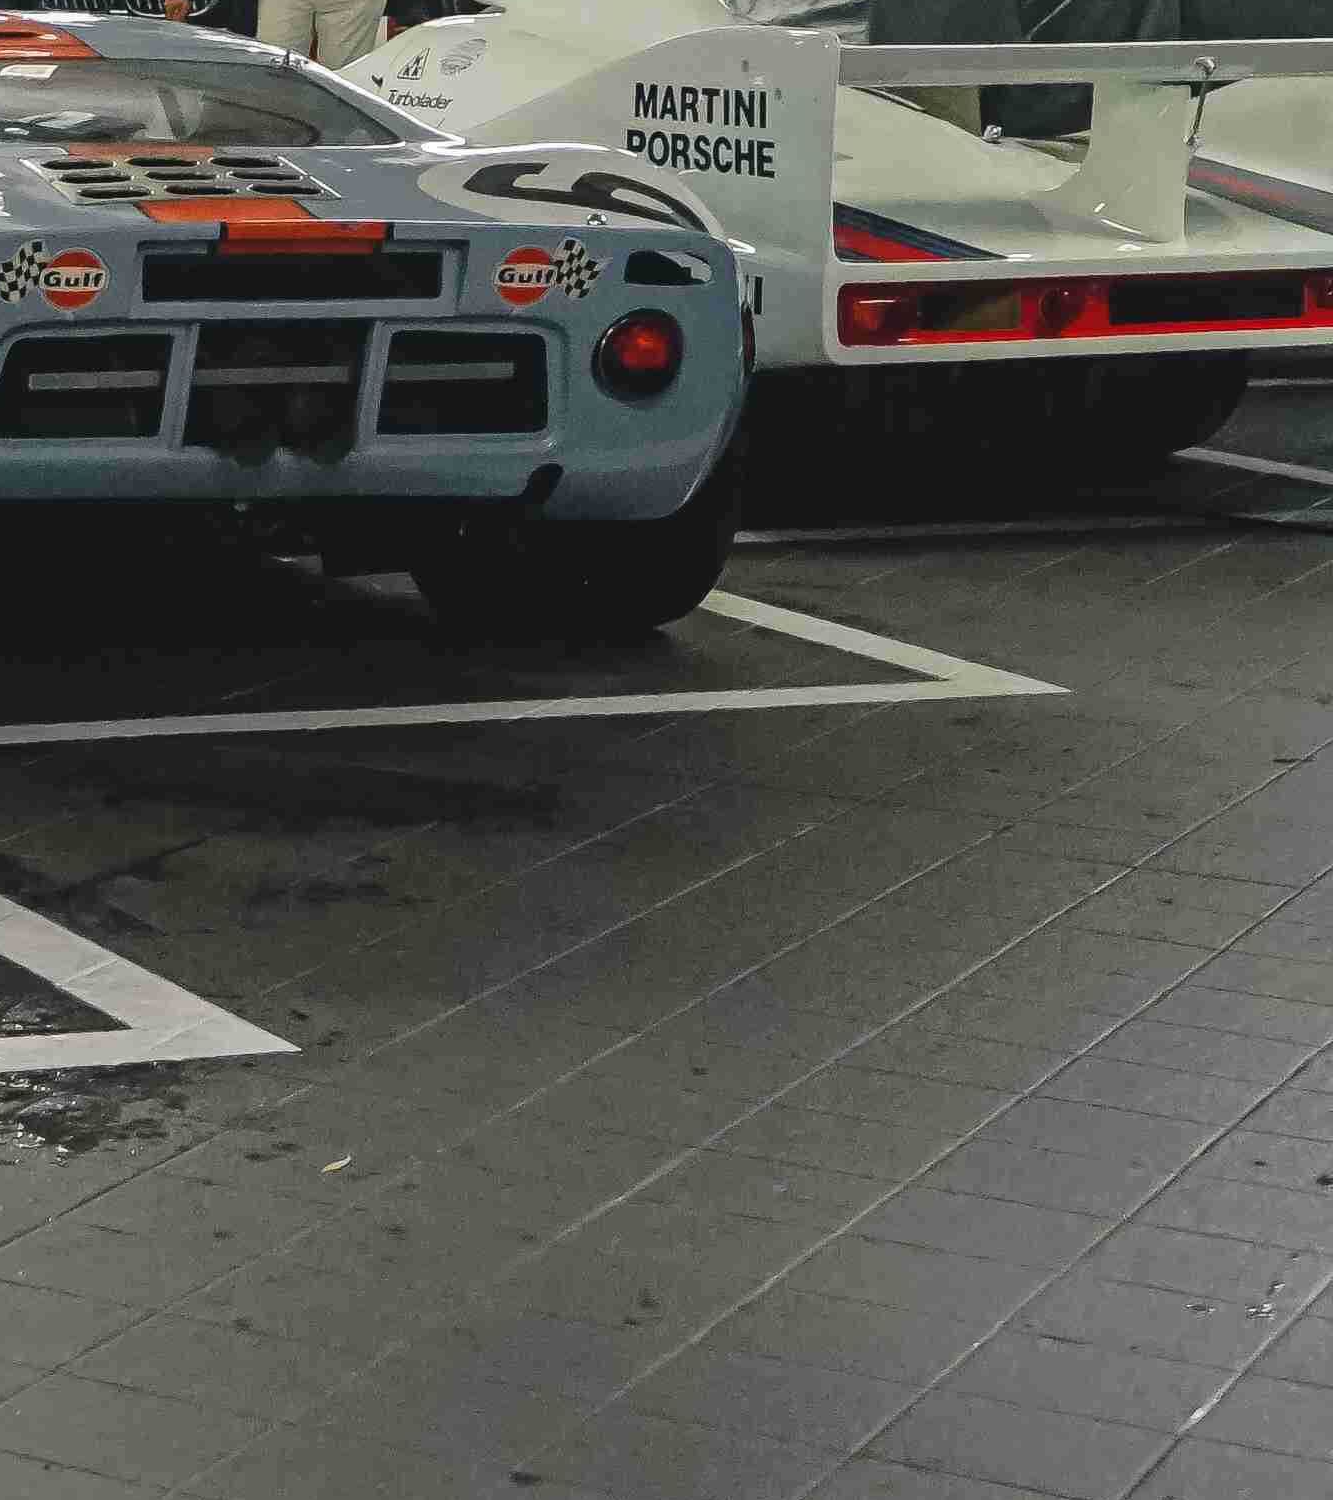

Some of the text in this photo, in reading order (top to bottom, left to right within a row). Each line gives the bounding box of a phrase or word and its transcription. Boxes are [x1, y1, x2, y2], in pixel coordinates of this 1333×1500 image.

[388, 88, 454, 110] Turbolader
[634, 82, 767, 129] MARTINI
[626, 129, 776, 179] PORSCHE
[43, 270, 104, 288] Gulf
[497, 267, 555, 284] Gulf
